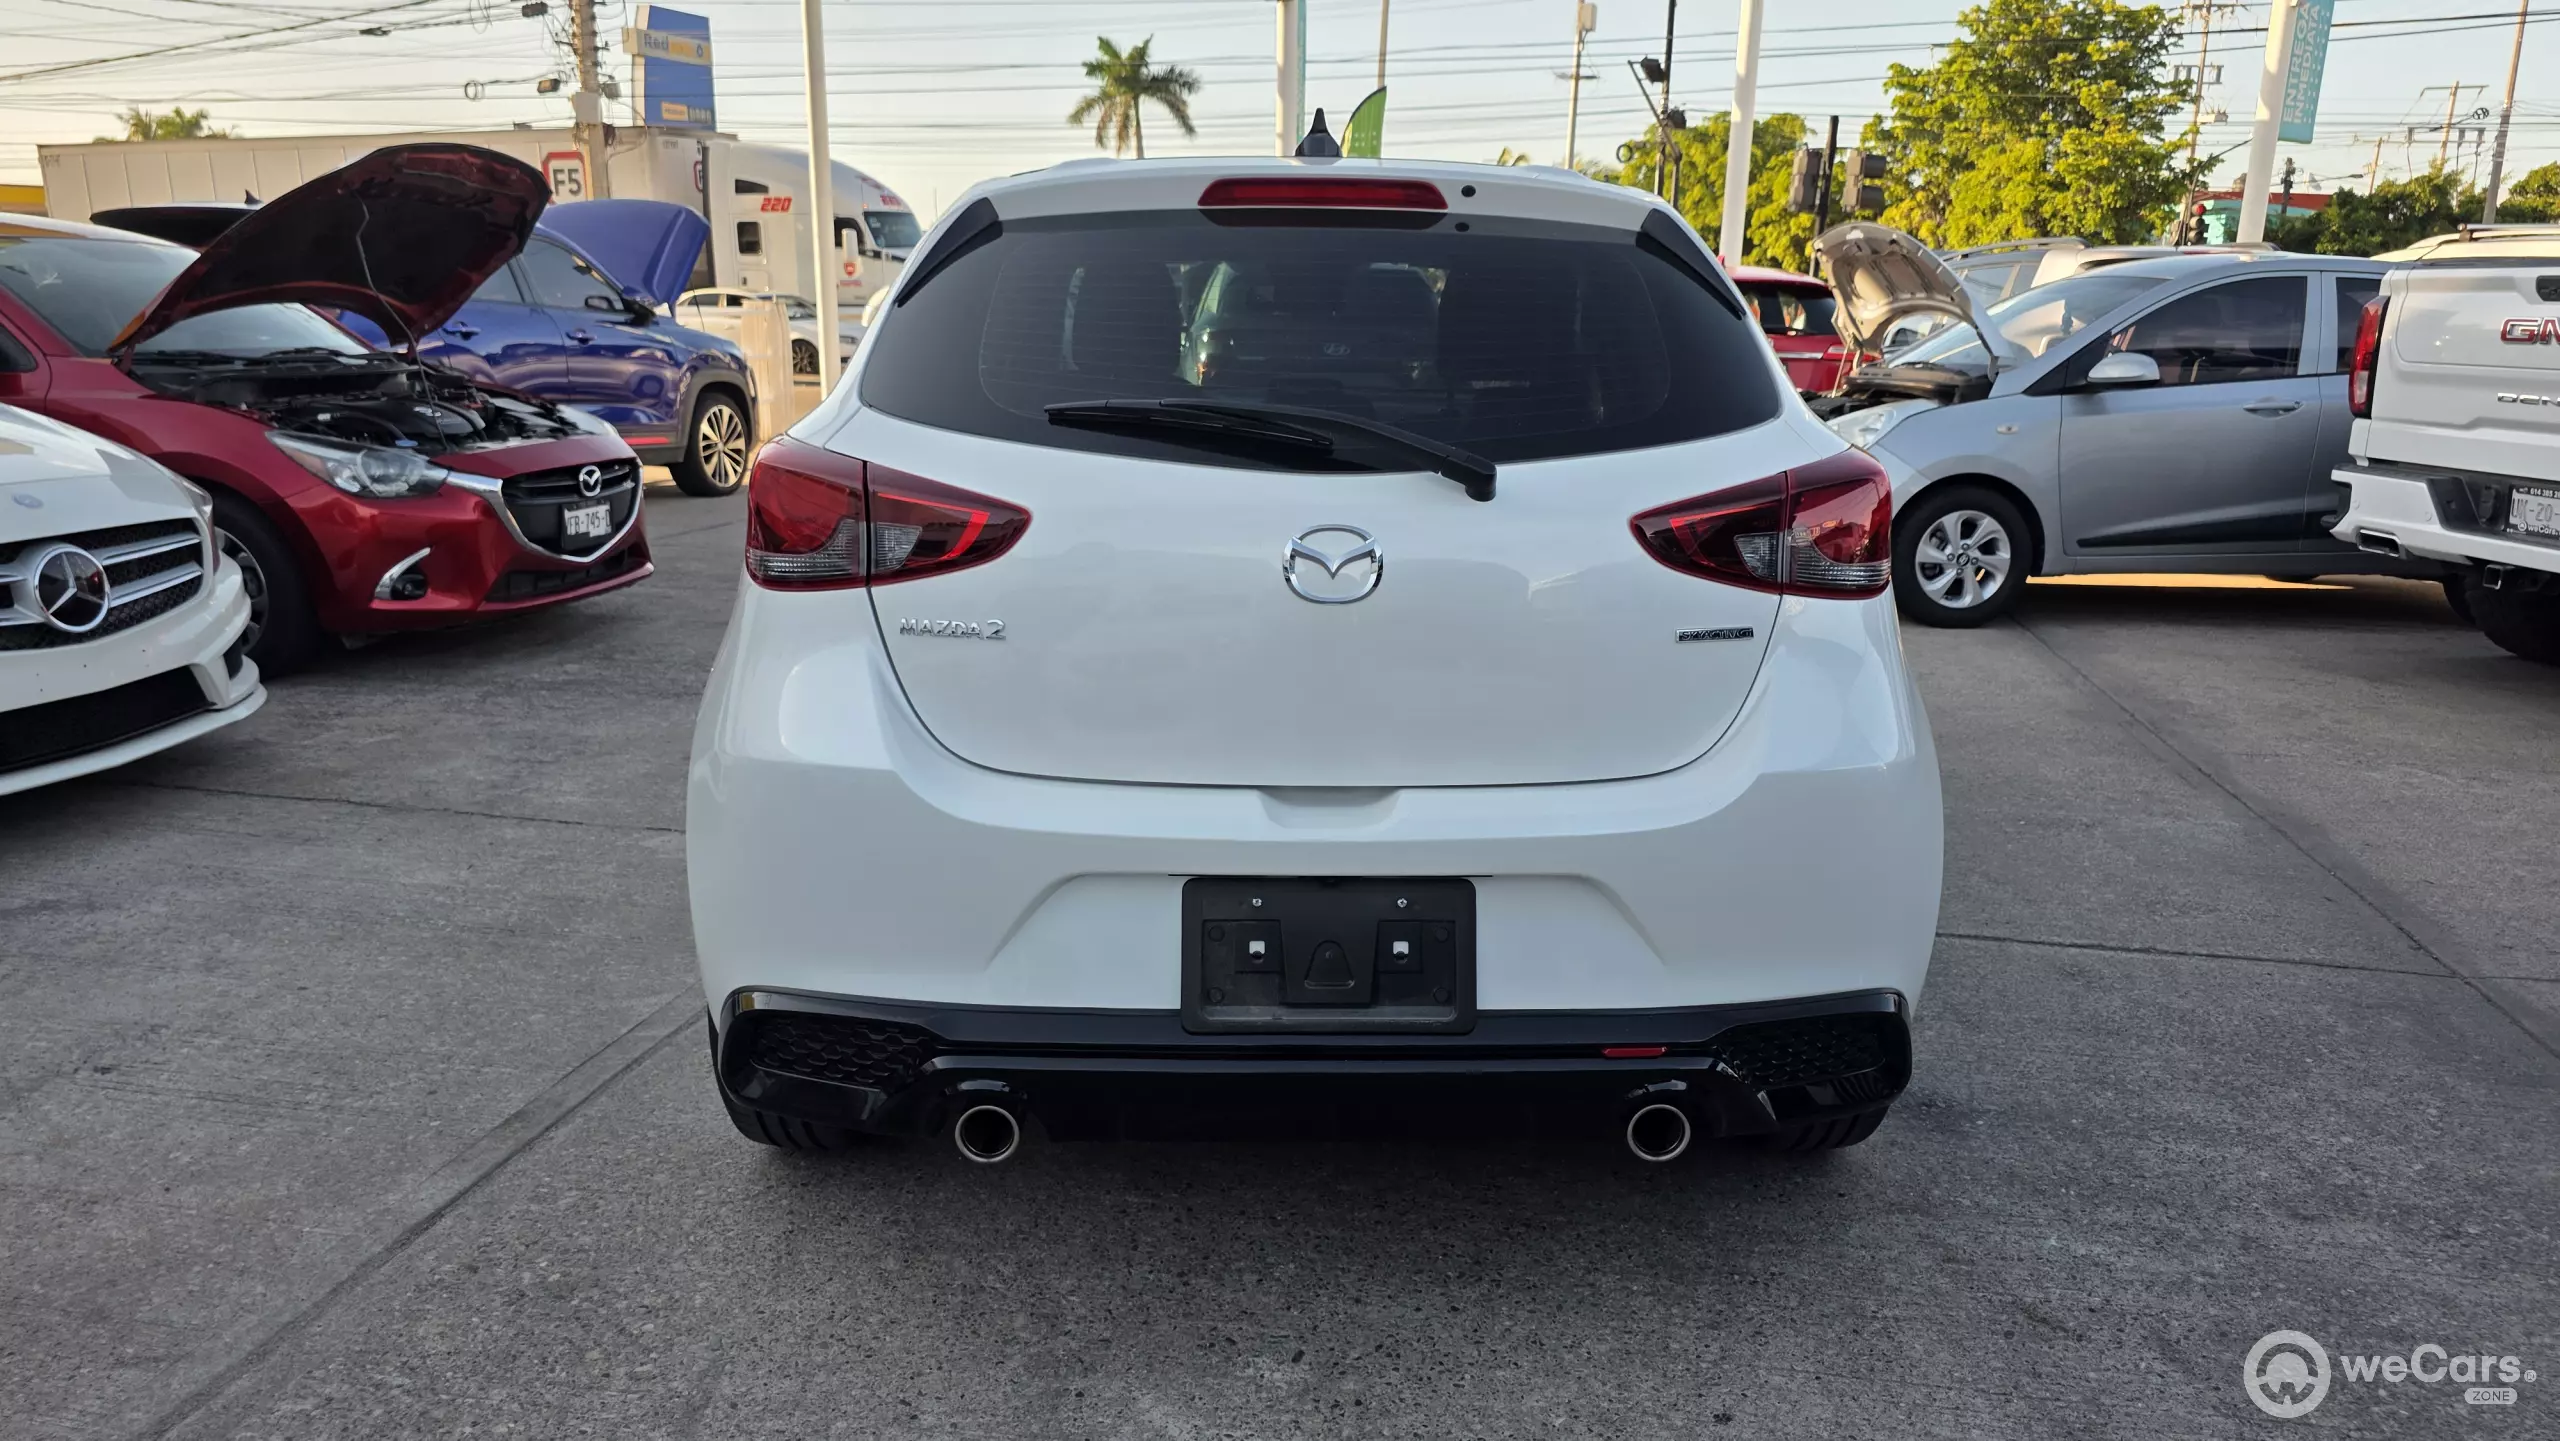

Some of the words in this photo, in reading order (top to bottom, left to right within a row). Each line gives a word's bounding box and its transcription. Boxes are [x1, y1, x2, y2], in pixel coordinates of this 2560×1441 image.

[2283, 2, 2310, 122] ENTREGA
[2294, 5, 2320, 124] INMEDIATA
[552, 168, 582, 197] F5
[760, 196, 793, 213] 220
